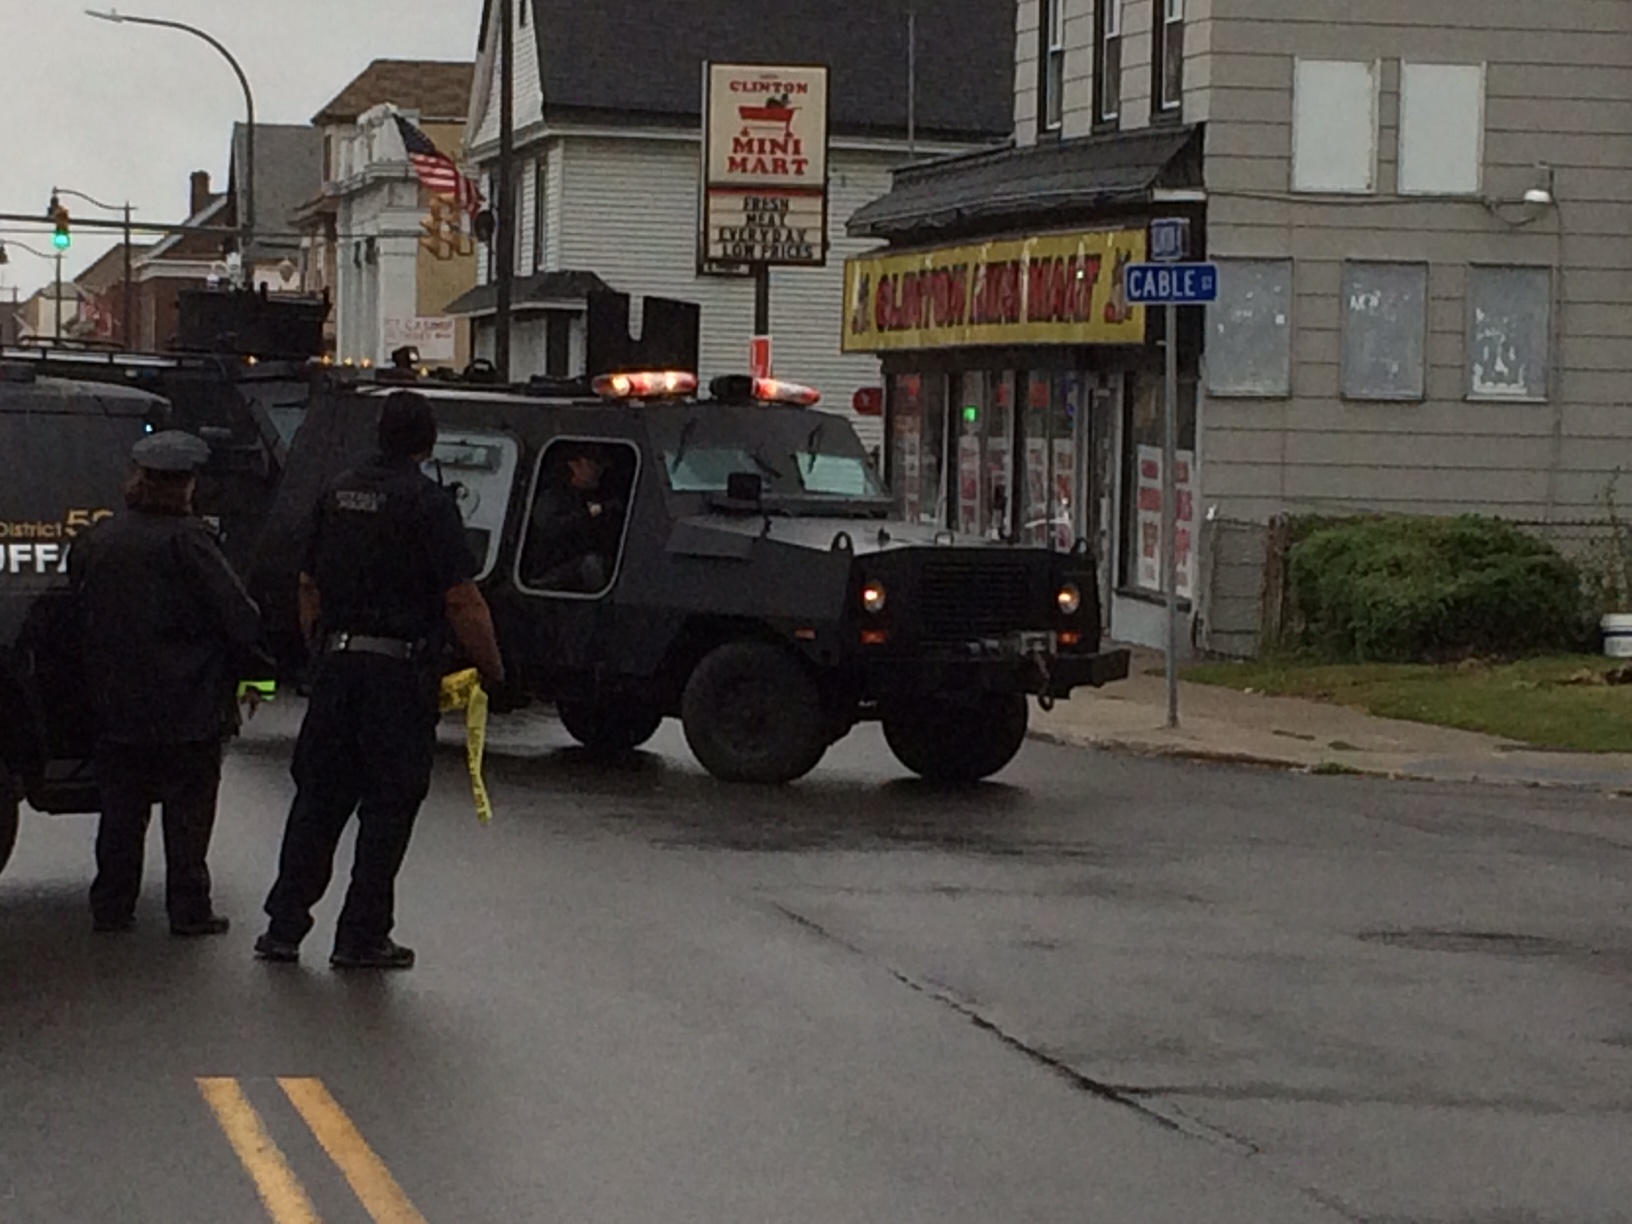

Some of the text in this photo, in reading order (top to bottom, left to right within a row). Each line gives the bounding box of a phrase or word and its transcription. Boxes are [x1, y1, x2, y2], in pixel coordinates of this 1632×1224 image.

[729, 81, 808, 94] CLINTON
[732, 137, 803, 155] MINI
[727, 157, 809, 175] MART
[744, 197, 789, 212] FRESH
[719, 227, 807, 243] EVERYDAY
[722, 244, 755, 258] LOW
[1129, 269, 1196, 298] CABLE
